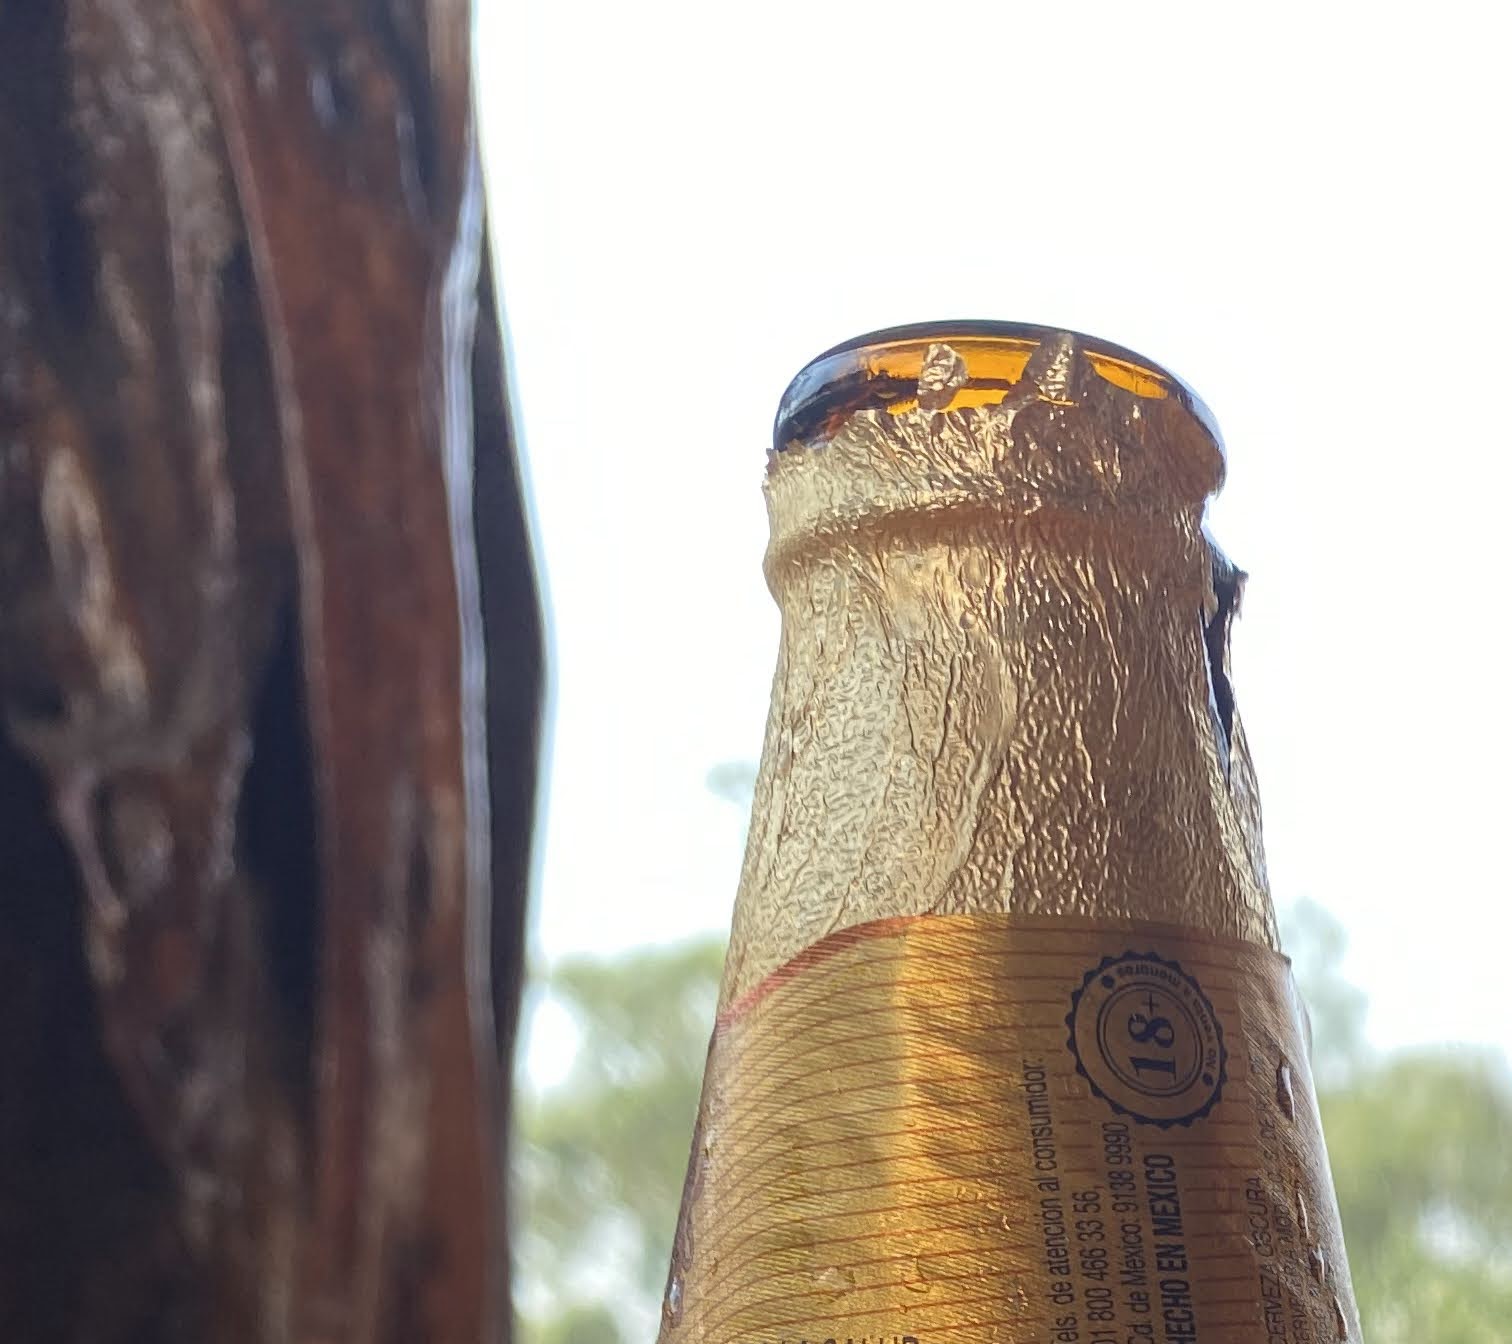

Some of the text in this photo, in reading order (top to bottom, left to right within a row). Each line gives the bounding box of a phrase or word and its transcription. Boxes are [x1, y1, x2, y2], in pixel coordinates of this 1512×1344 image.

[1022, 1059, 1057, 1171] consumidor:
[1102, 1121, 1133, 1165] 9990
[1031, 1176, 1061, 1193] al
[1108, 1169, 1139, 1214] 9138
[1145, 1154, 1183, 1236] MEXICO
[1042, 1196, 1070, 1276] atención
[1076, 1219, 1105, 1243] 33
[1246, 1175, 1275, 1258] OSCURA
[1081, 1248, 1109, 1281] 466
[1119, 1216, 1146, 1286] México:
[1156, 1243, 1187, 1272] EN
[1052, 1281, 1075, 1306] de
[1087, 1287, 1116, 1321] 800
[1123, 1289, 1152, 1313] de
